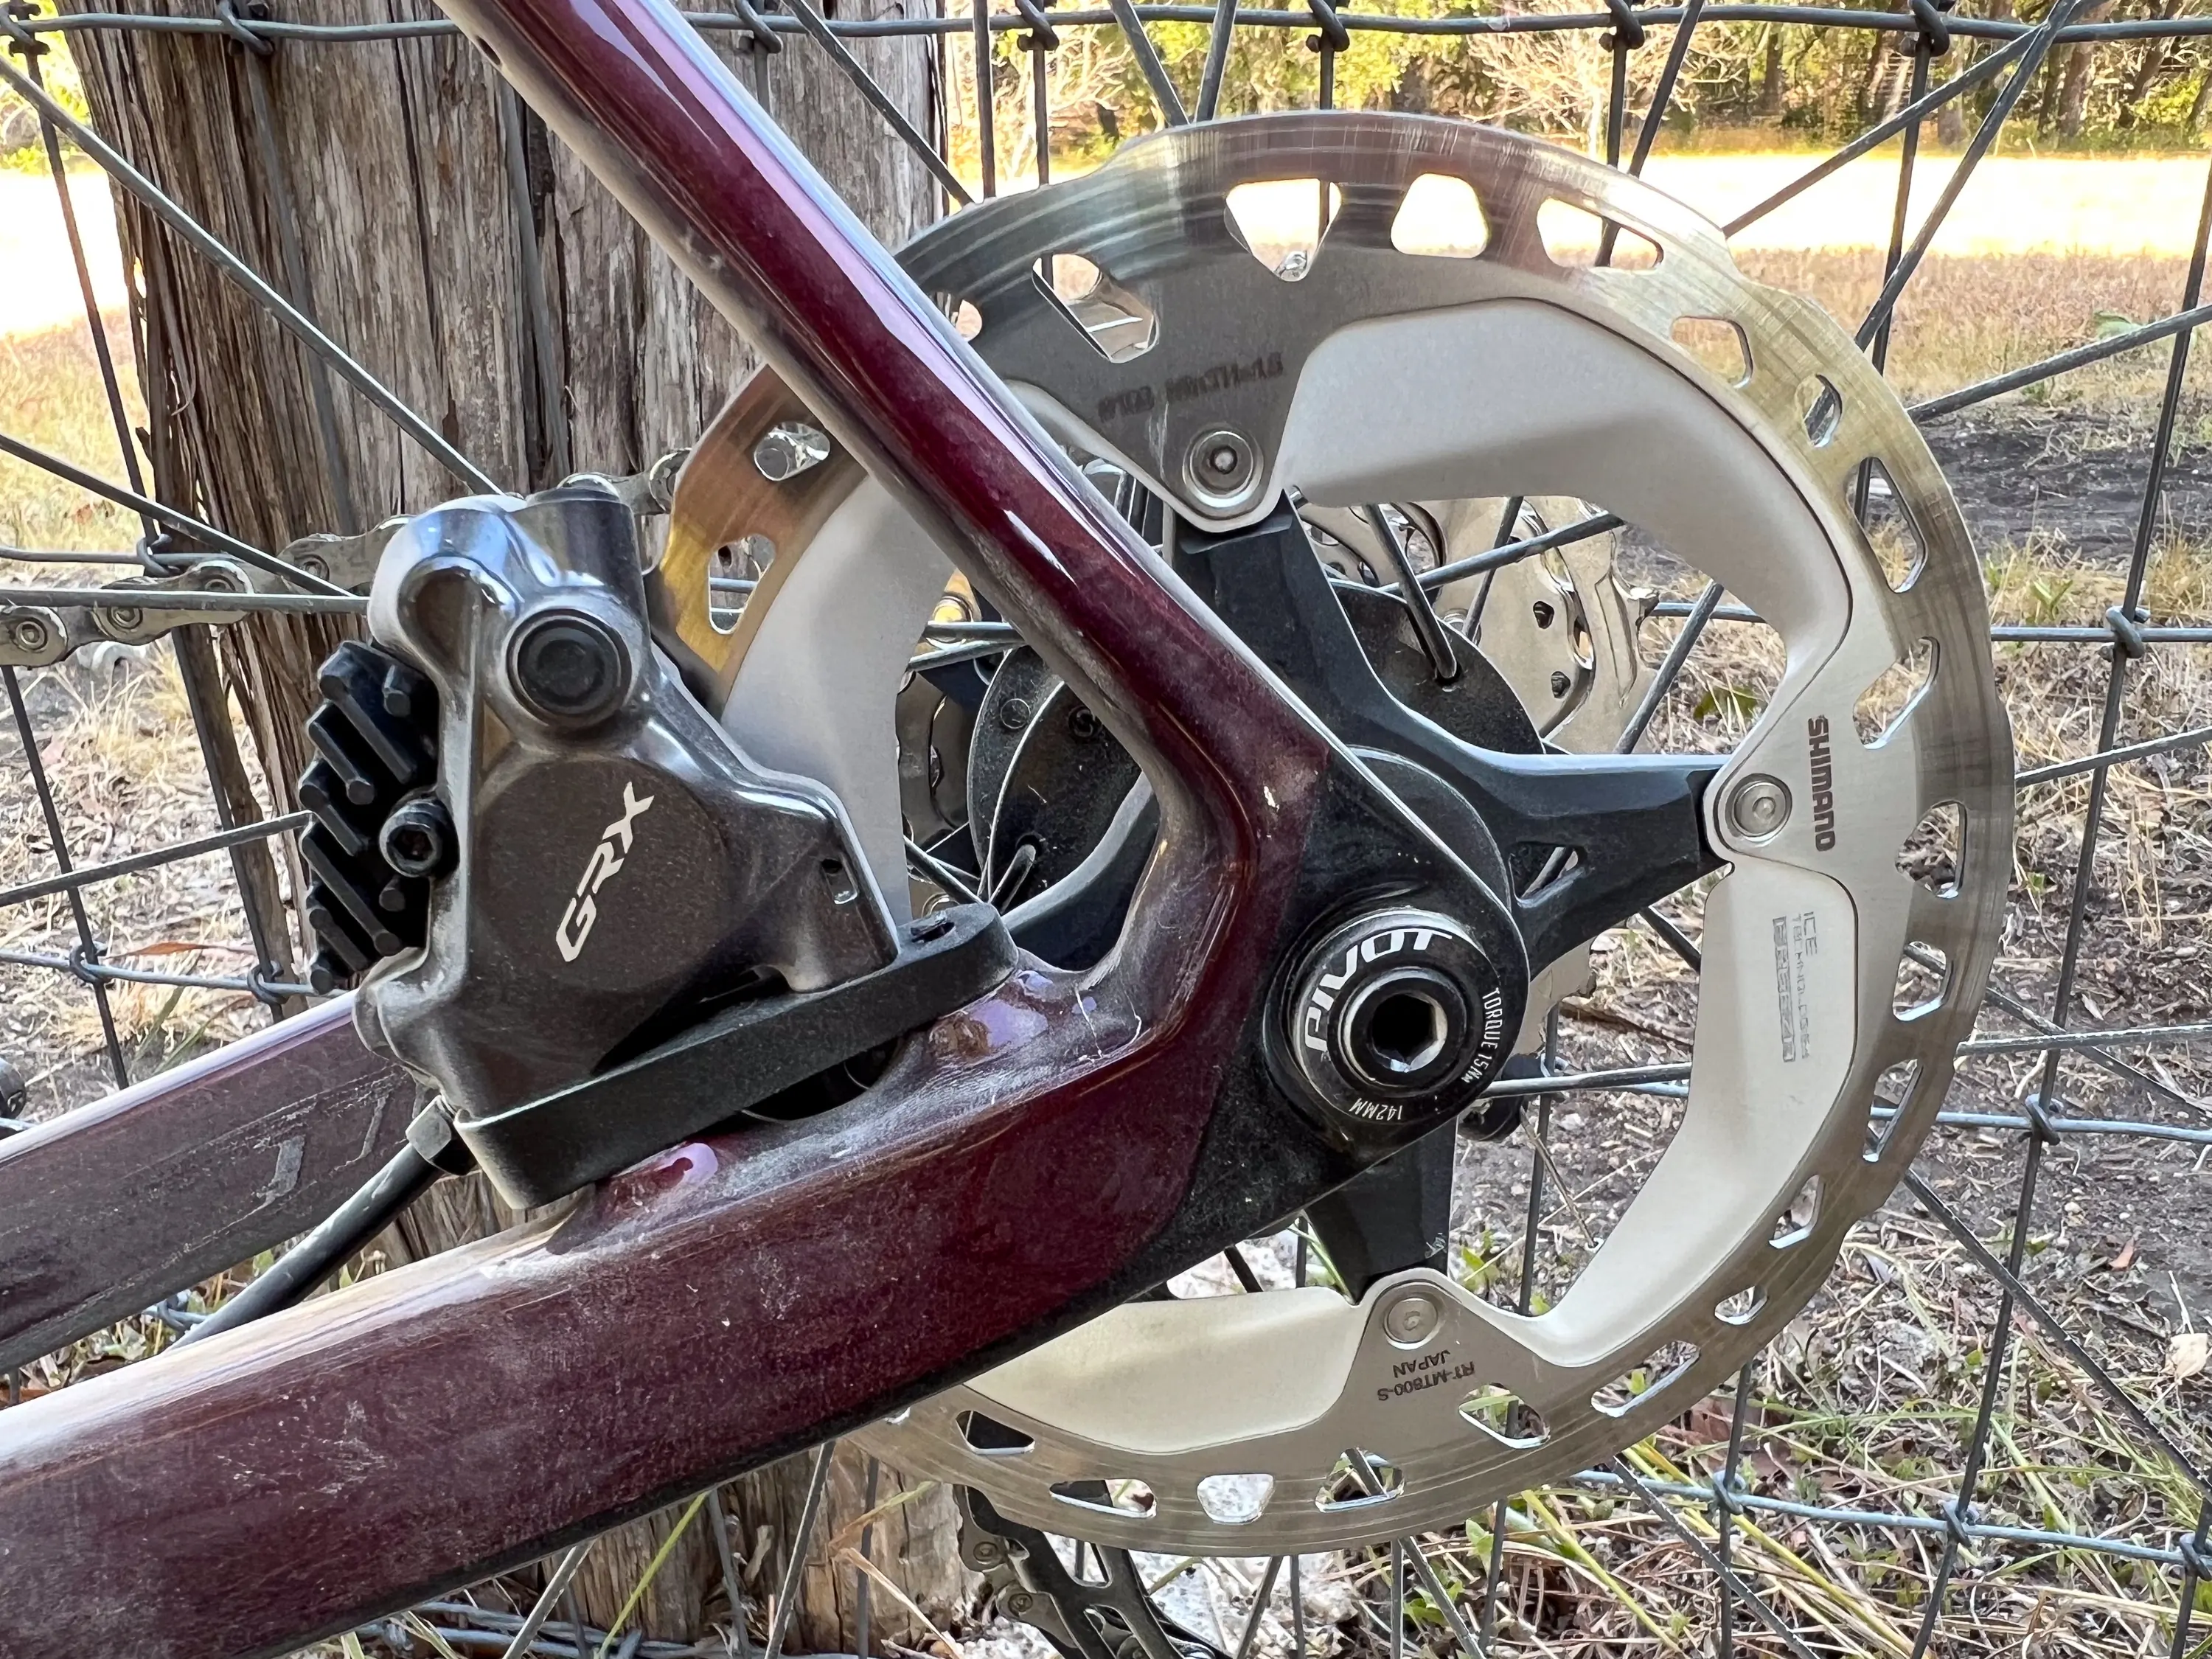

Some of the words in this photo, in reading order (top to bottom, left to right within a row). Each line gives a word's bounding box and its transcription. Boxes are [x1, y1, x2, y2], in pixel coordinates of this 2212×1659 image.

[1807, 714, 1836, 852] SHIMANO
[555, 781, 655, 962] GRX
[1804, 911, 1818, 956] ICE
[1304, 928, 1453, 1053] PIVOT
[1481, 987, 1503, 1050] TORQUE
[1349, 1097, 1403, 1121] 142MM
[1392, 1349, 1451, 1379] JAPAN
